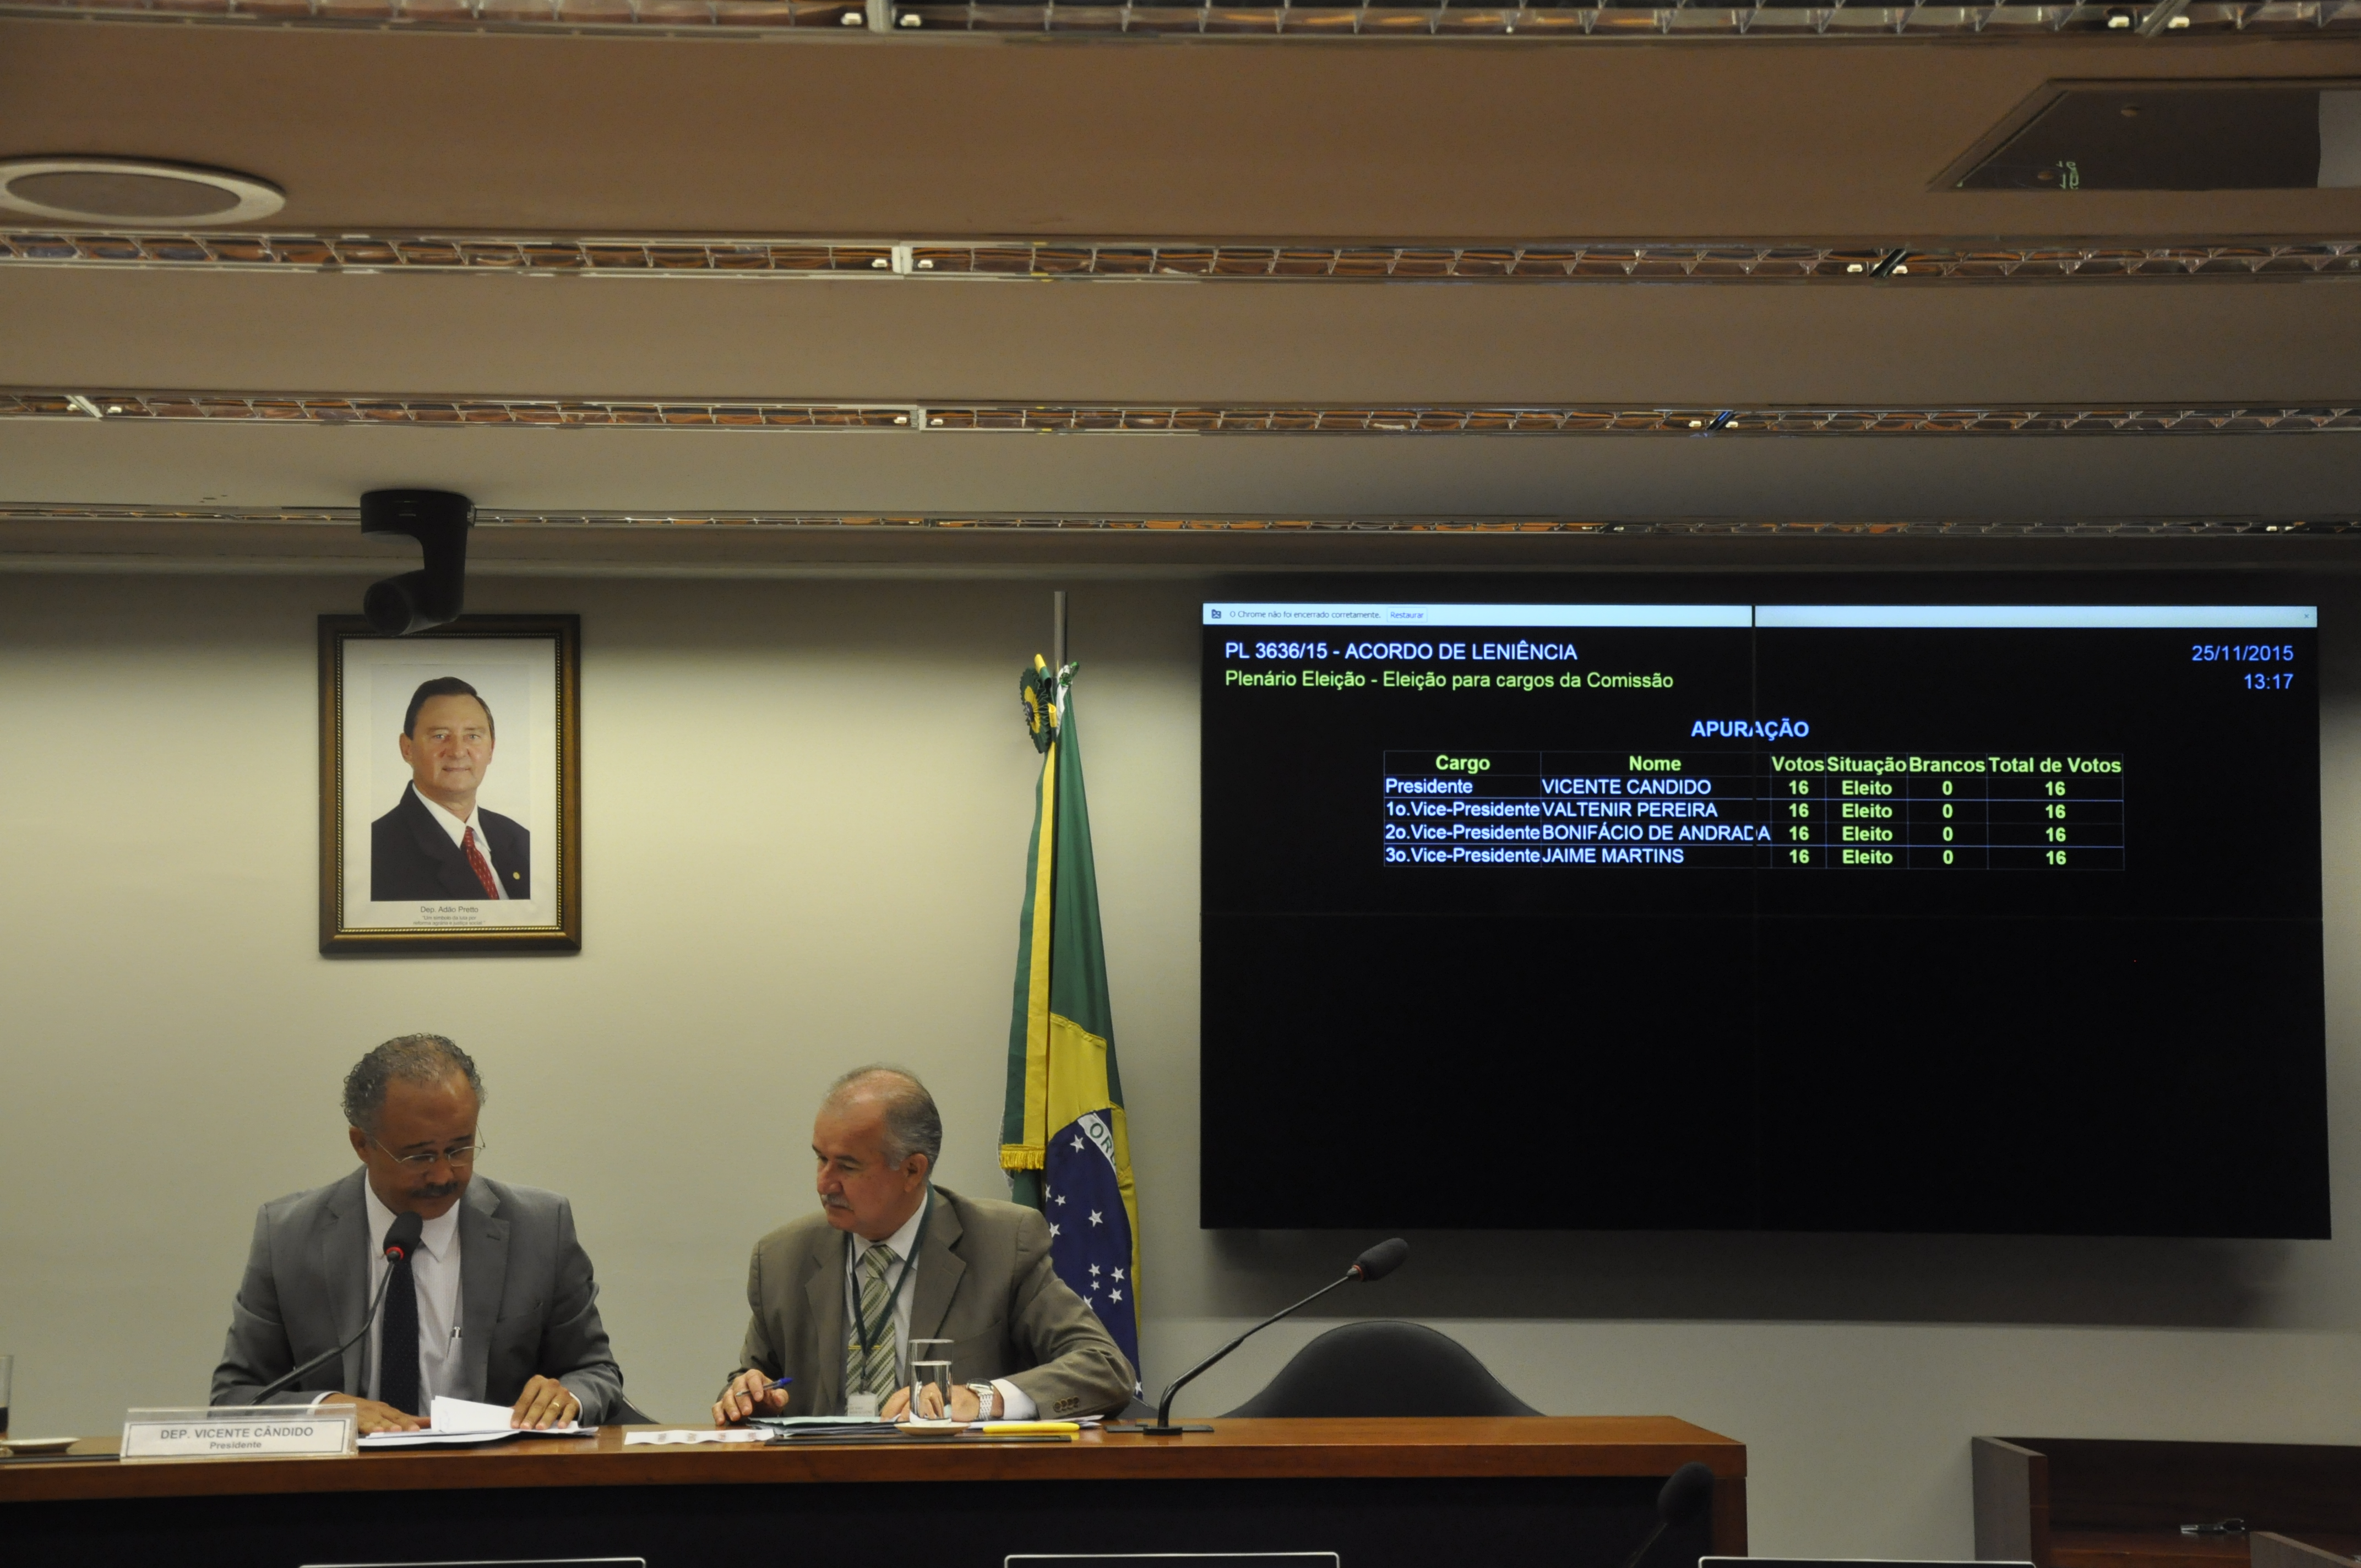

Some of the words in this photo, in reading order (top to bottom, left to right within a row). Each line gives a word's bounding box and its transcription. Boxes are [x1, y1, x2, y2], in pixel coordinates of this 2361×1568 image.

[1225, 641, 1250, 659] PL
[1255, 641, 1328, 659] 3636/15
[1344, 642, 1433, 660] ACORDO
[1438, 643, 1466, 660] DE
[1472, 639, 1578, 660] LENIÊNCIA
[2192, 645, 2294, 661] 25/11/2015
[1226, 670, 1297, 687] Plenário
[1302, 670, 1366, 690] Eleição
[1383, 671, 1446, 691] Eleição
[1452, 675, 1490, 691] para
[1496, 676, 1554, 692] cargos
[1559, 672, 1581, 688] da
[1587, 672, 1673, 688] Comissão
[2244, 673, 2294, 689] 13:17
[1690, 717, 1810, 742] APURAÇÃO
[1435, 754, 1490, 774] Cargo
[1629, 755, 1682, 771] Nome
[1771, 756, 1825, 771] Votos
[1827, 756, 1907, 776] Situação
[1909, 756, 1985, 772] Brancos
[1988, 757, 2034, 772] Total
[2039, 757, 2062, 772] de
[2067, 757, 2121, 773] Votos
[1385, 777, 1473, 794] Presidente
[1541, 778, 1622, 794] VICENTE
[1626, 778, 1712, 795] CANDIDO
[1789, 780, 1809, 795] 16
[1842, 780, 1892, 795] Eleito
[1942, 781, 1953, 796] 0
[2045, 781, 2065, 796] 16
[1386, 800, 1541, 817] 1o.Vice-Presidente
[1541, 801, 1632, 817] VALTENIR
[1637, 801, 1718, 818] PEREIRA
[1789, 803, 1809, 818] 16
[1842, 803, 1892, 818] Eleito
[1943, 803, 1953, 818] 0
[2046, 804, 2066, 819] 16
[1385, 823, 1541, 840] 2o.Vice-Presidente
[1542, 821, 1644, 841] BONIFÁCIO
[1648, 824, 1674, 841] DE
[1678, 825, 1771, 841] ANDRADA
[1789, 826, 1809, 841] 16
[1842, 826, 1893, 841] Eleito
[1943, 826, 1953, 841] 0
[2046, 827, 2066, 842] 16
[1385, 846, 1541, 863] 3o.Vice-Presidente
[1542, 847, 1597, 863] JAIME
[1602, 847, 1684, 864] MARTINS
[1789, 849, 1809, 864] 16
[1842, 849, 1893, 864] Eleito
[1943, 850, 1954, 864] 0
[2046, 850, 2066, 865] 16
[160, 1430, 190, 1439] DEP.
[195, 1428, 249, 1438] VICENTE
[254, 1425, 313, 1437] CÂNDIDO
[210, 1441, 262, 1449] Presidente
